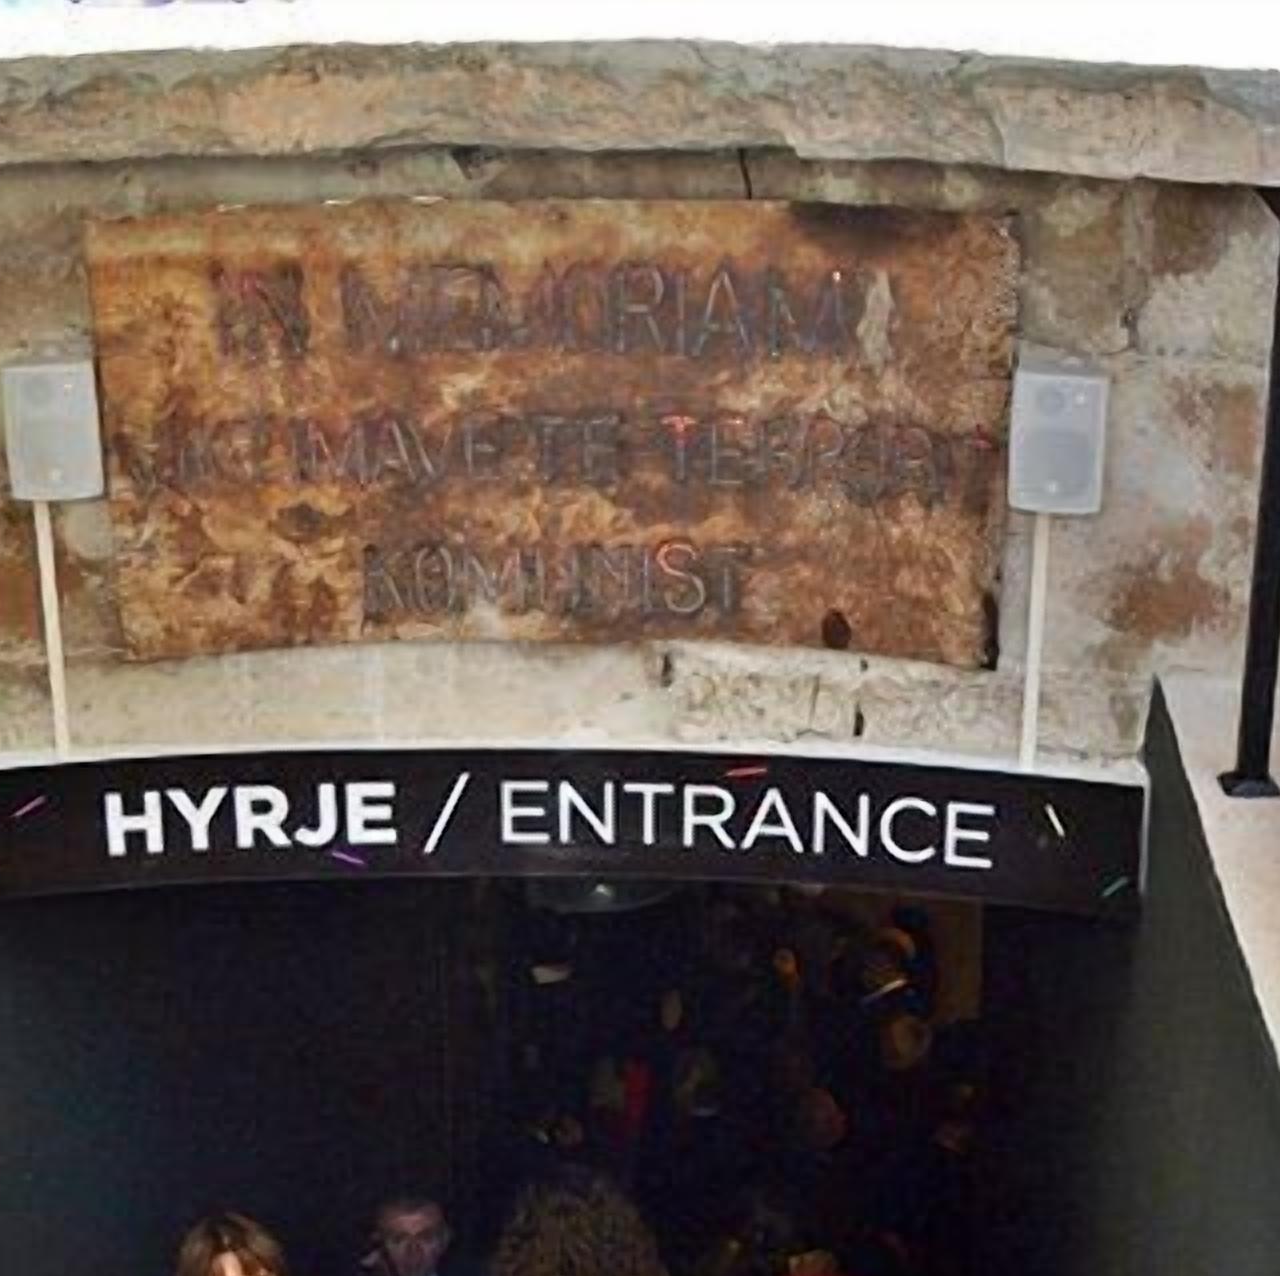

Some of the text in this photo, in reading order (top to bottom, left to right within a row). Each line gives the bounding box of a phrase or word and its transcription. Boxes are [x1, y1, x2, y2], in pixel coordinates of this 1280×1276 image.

[360, 540, 752, 616] KOMUNIST
[103, 771, 997, 870] HYRJE / ENTRANCE
